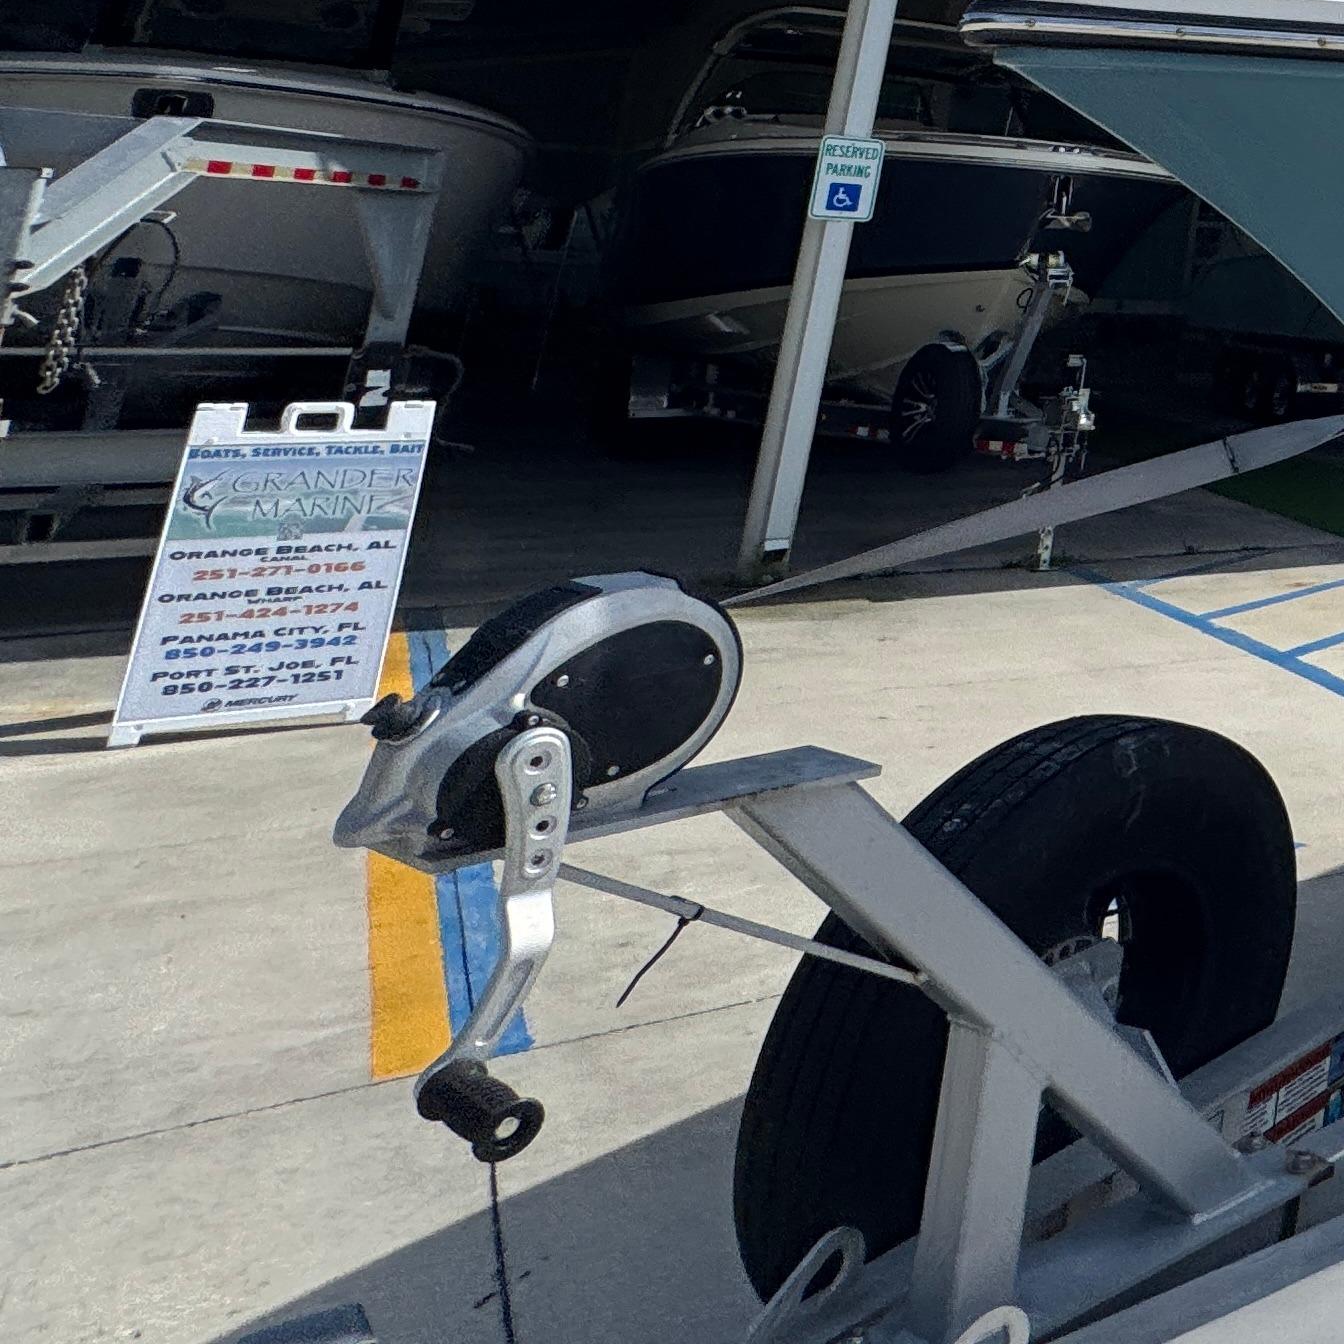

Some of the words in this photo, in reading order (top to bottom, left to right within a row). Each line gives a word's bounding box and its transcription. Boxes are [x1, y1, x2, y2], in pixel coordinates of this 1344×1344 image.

[825, 143, 879, 160] RESERVED
[825, 162, 871, 178] PARKING
[252, 446, 321, 457] SERVICE,
[326, 444, 385, 455] TACKLE,
[389, 443, 425, 454] BAIT
[232, 467, 414, 493] GRANDER
[251, 494, 405, 519] MARINE
[169, 547, 269, 561] ORANGE
[275, 543, 359, 555] BEACH,
[366, 540, 397, 551] AL
[260, 555, 309, 563] CANAL
[192, 560, 366, 582] 251-271-0166
[157, 588, 258, 604] ORANGE
[266, 584, 351, 596] BEACH,
[357, 580, 388, 591] AL
[178, 601, 359, 625] 251-424-1274
[160, 630, 265, 646] PANAMA
[273, 625, 330, 637] CITY,
[337, 622, 367, 632] FL
[165, 635, 358, 660] 850-249-3942
[150, 668, 219, 683] PORT
[224, 665, 261, 676] ST.
[268, 660, 324, 672] JOE,
[330, 656, 361, 667] FL
[161, 669, 344, 696] 850-227-1251
[224, 693, 299, 708] MERCURY
